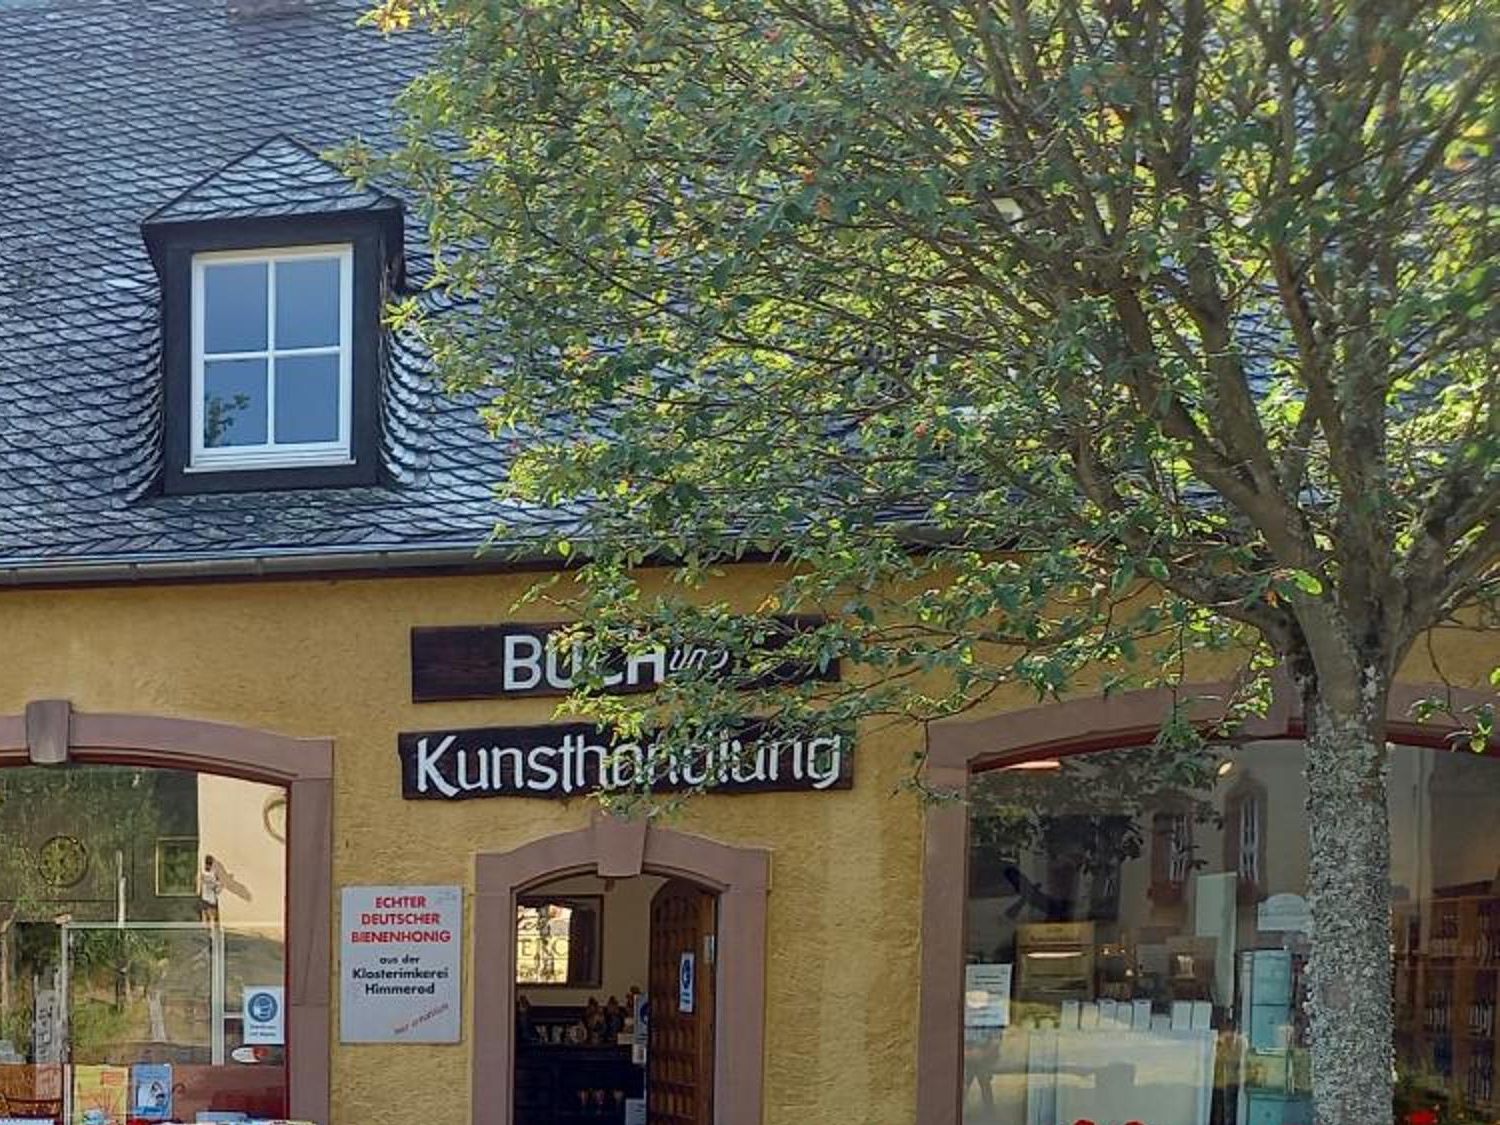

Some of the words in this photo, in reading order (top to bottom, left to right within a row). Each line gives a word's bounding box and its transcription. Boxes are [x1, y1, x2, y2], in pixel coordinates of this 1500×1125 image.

[375, 896, 426, 909] ECHTER
[361, 913, 441, 925] DEUTSCHER
[351, 930, 451, 943] BIENENHONIG
[379, 957, 398, 965] aus
[401, 954, 420, 964] der
[352, 967, 449, 979] Klosterimkerei
[365, 982, 435, 995] Himmerod
